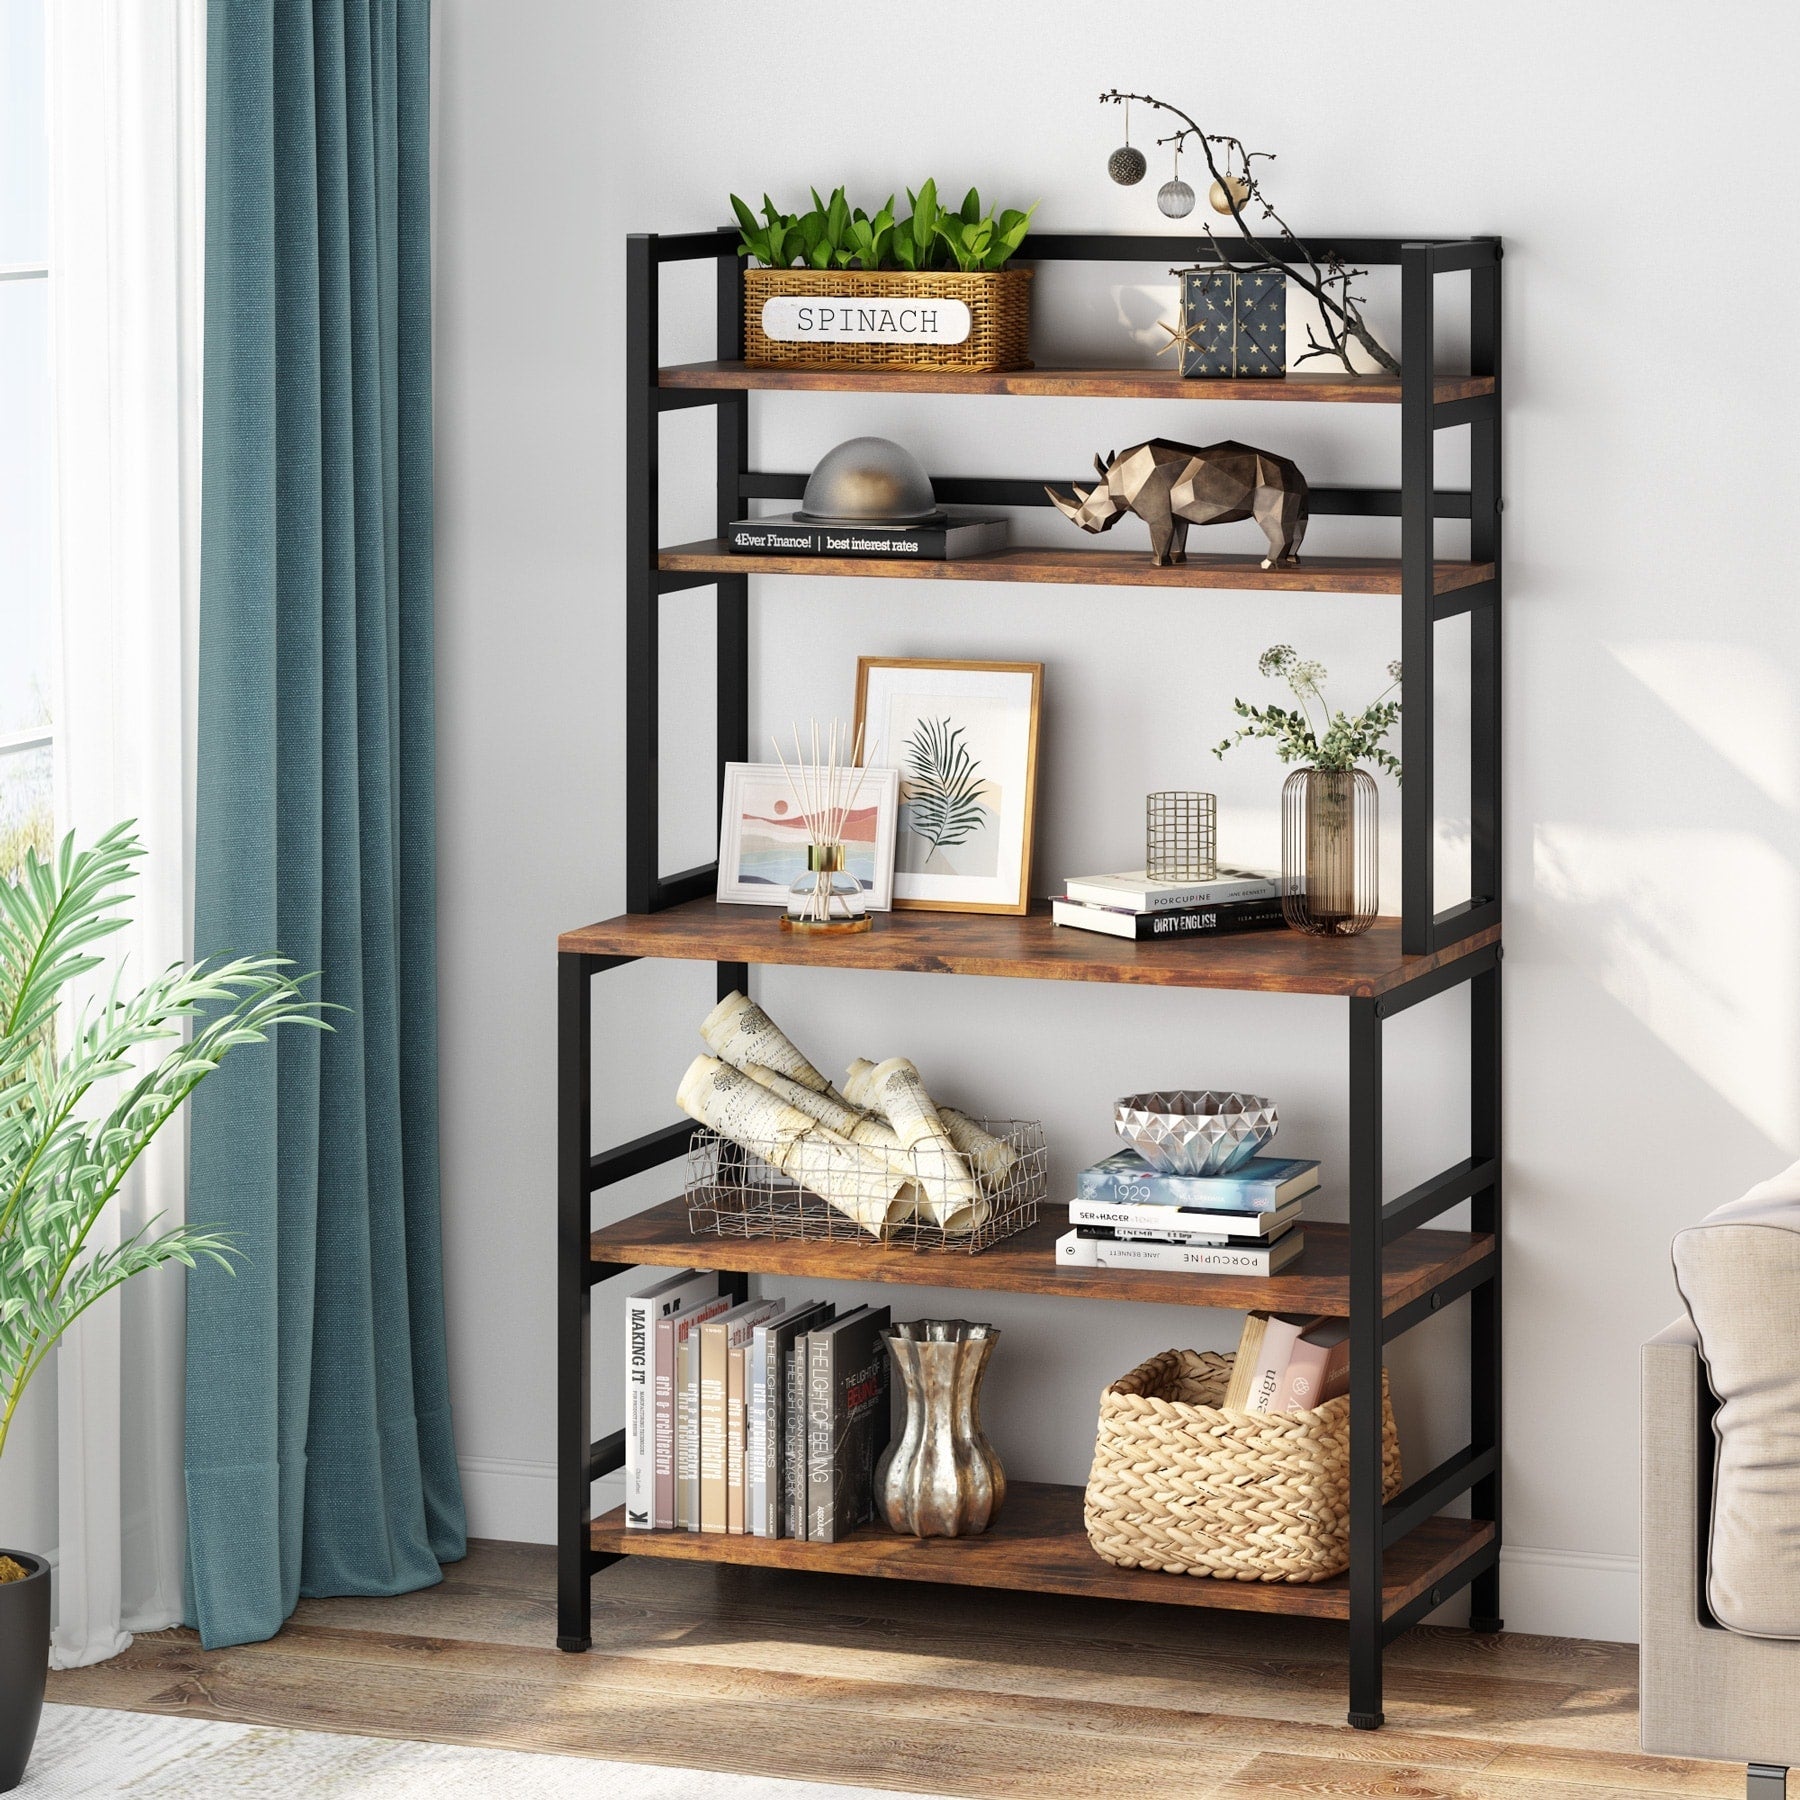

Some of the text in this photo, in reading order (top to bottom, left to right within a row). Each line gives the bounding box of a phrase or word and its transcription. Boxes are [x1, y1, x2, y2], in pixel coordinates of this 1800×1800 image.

[797, 307, 939, 333] SPINACH
[735, 533, 811, 548] 4Ever Finance!
[827, 536, 919, 552] best interest rates
[1154, 893, 1211, 906] PORCUPINE
[1242, 888, 1266, 897] BENNETT
[1154, 916, 1179, 933] DIRTY
[1180, 913, 1217, 931] ENGLISH
[1114, 1184, 1151, 1202] 1929
[1109, 1249, 1142, 1257] BENNETT
[1183, 1253, 1258, 1266] PORCUPINE
[631, 1309, 646, 1385] MAKING IT
[656, 1376, 672, 1396] arts
[701, 1379, 726, 1400] arts
[728, 1398, 743, 1416] arts
[767, 1340, 776, 1468] THE LIGHT OF PARIS
[788, 1383, 796, 1413] LIGHT
[797, 1399, 804, 1412] OF
[812, 1340, 829, 1483] THE LIGHT OF BEIJING
[656, 1413, 673, 1475] architecture
[688, 1419, 699, 1480] architecture
[701, 1416, 727, 1480] architecture
[728, 1431, 744, 1487] architecture
